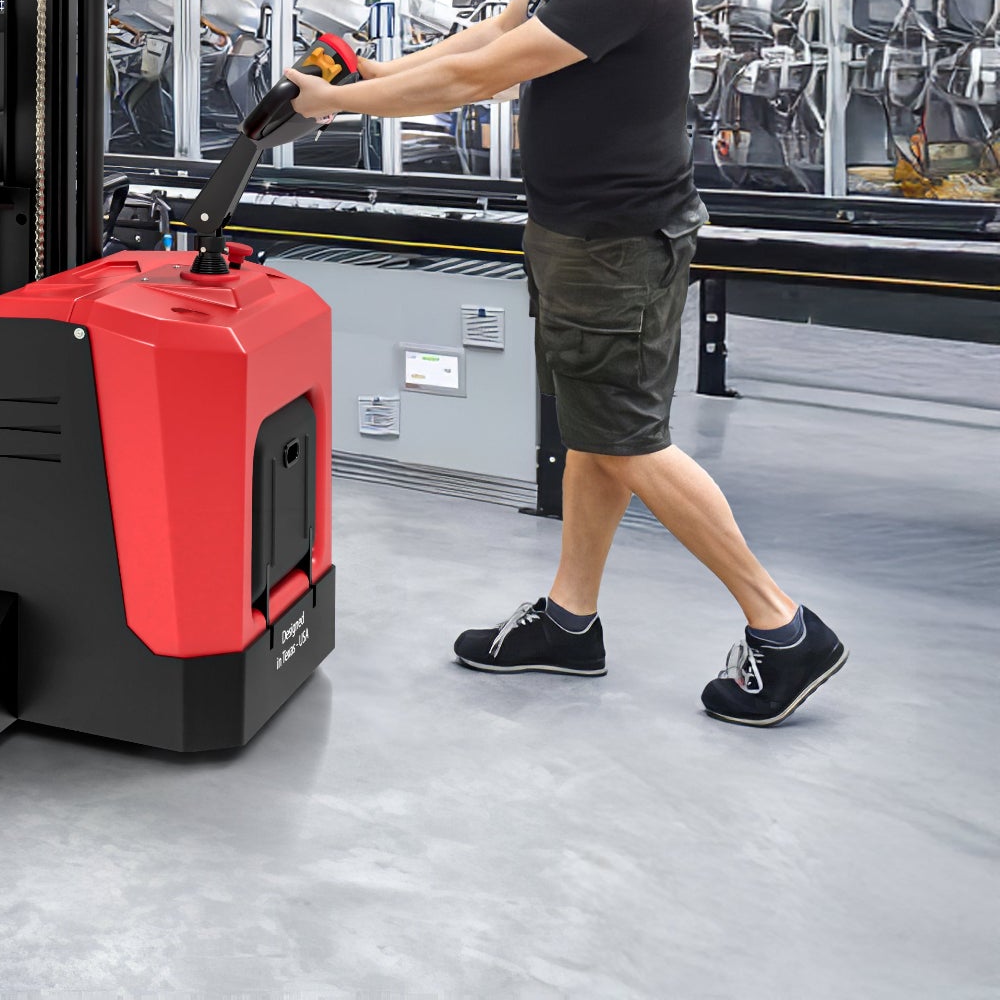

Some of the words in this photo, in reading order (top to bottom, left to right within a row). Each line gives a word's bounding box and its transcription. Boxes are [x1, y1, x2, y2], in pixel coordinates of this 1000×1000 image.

[282, 611, 305, 644] Designed
[276, 657, 283, 670] in
[282, 643, 296, 664] Texas
[299, 628, 309, 647] USA
